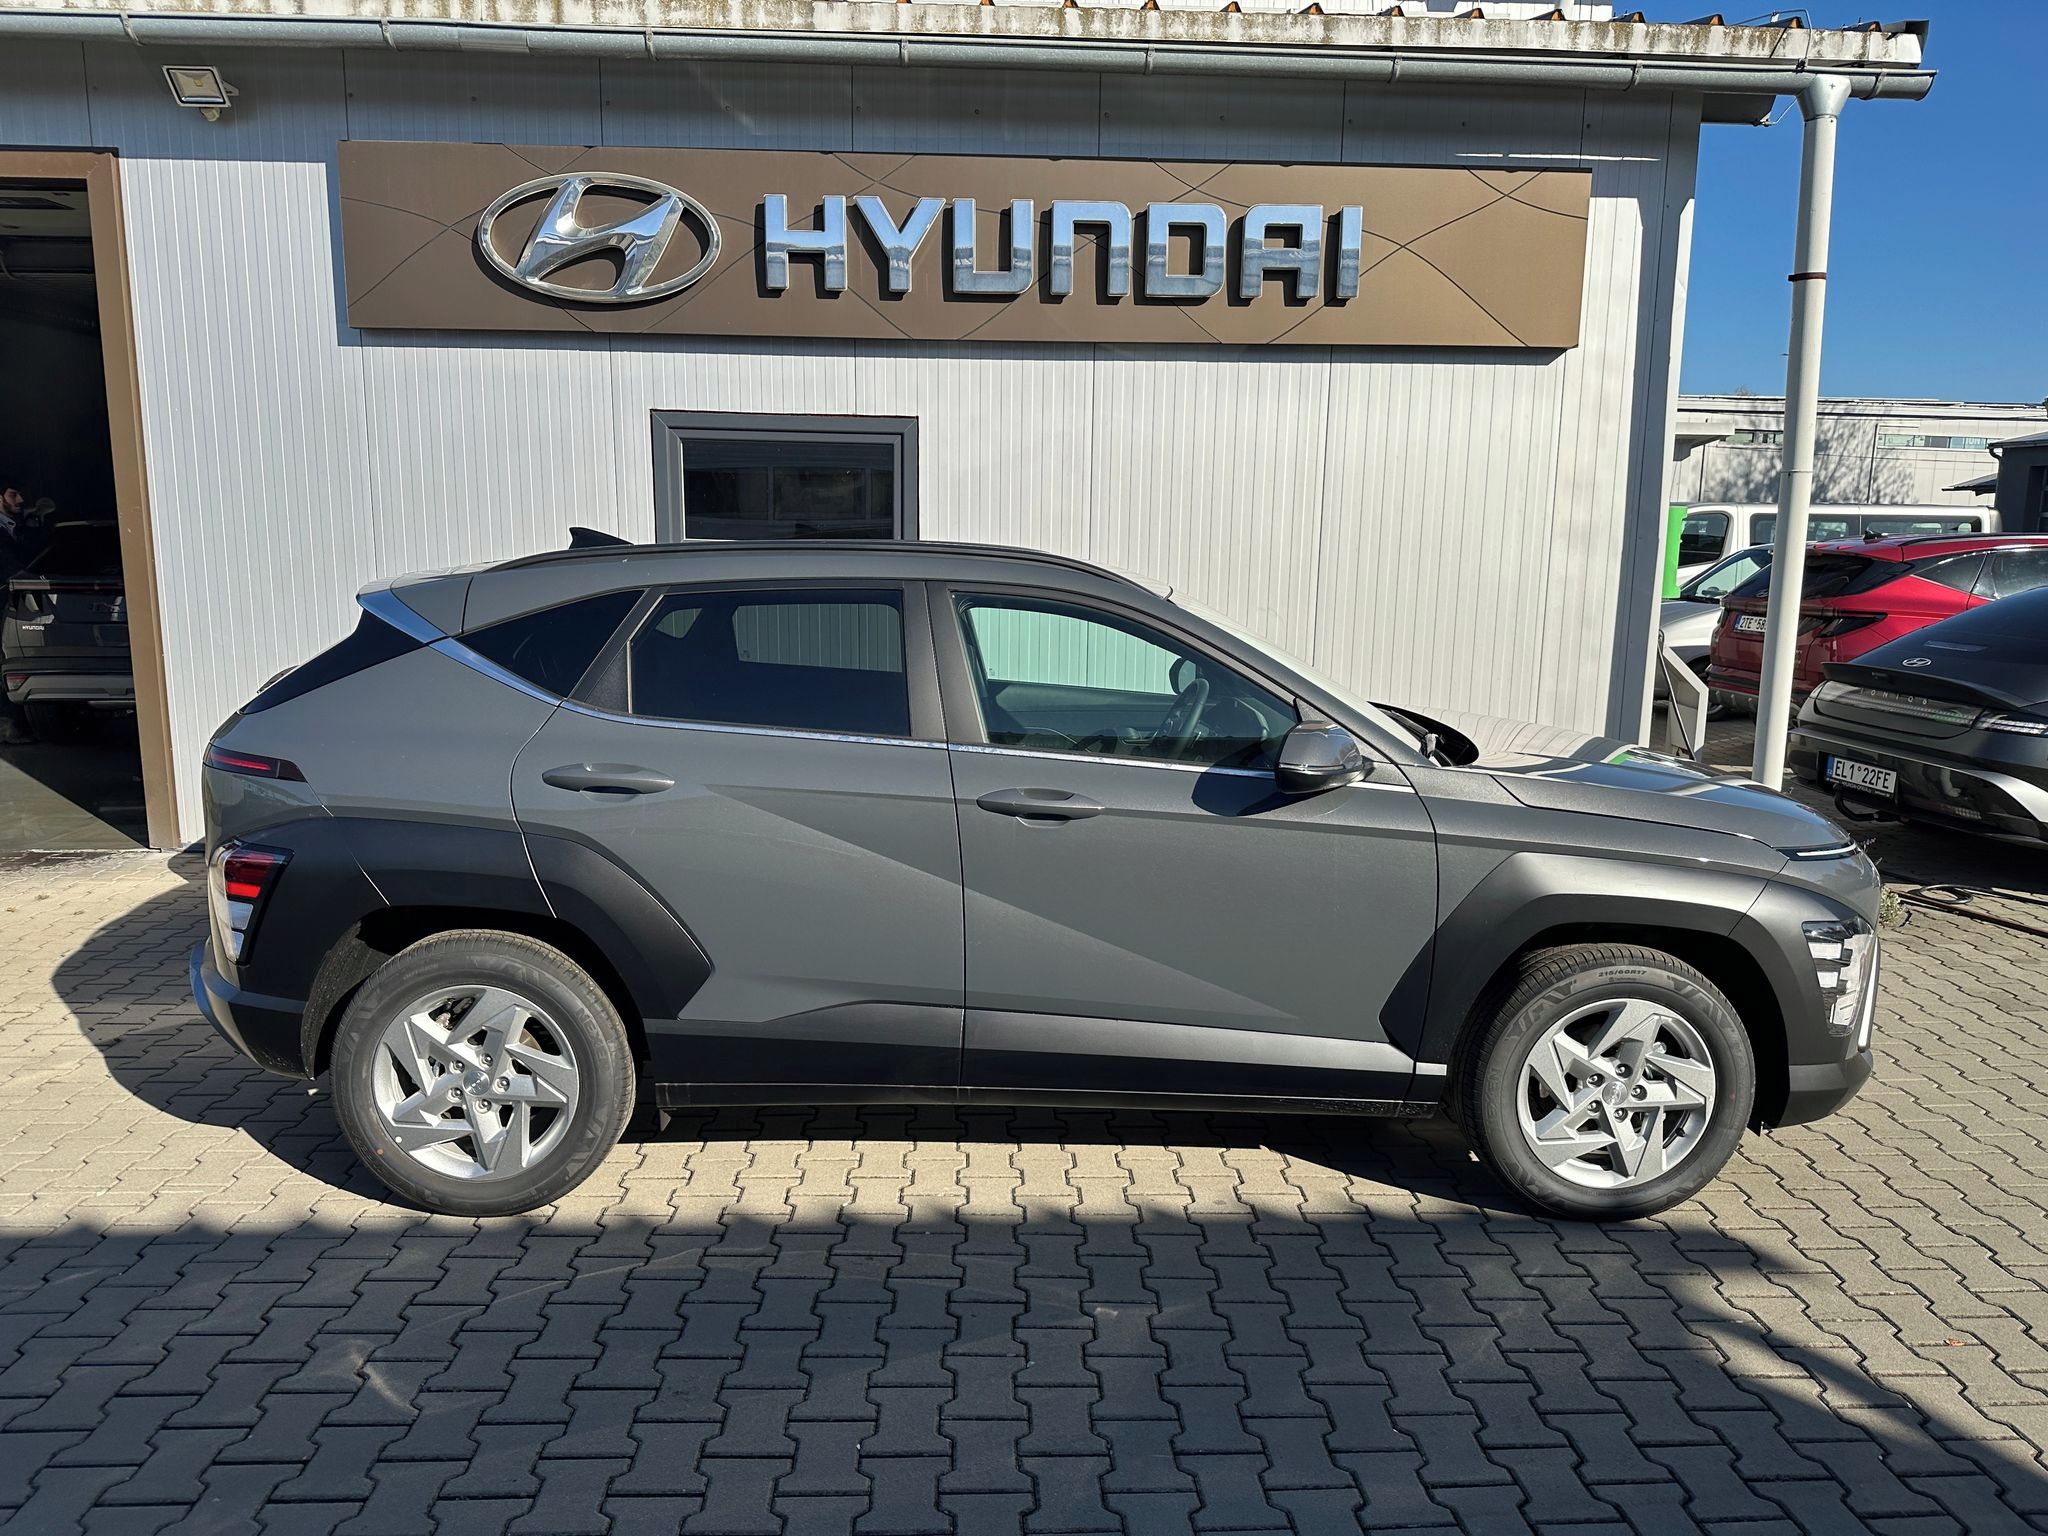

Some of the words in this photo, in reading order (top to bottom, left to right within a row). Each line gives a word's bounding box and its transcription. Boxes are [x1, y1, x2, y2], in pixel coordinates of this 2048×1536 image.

[763, 193, 1363, 299] HYUNDAI
[1740, 617, 1754, 629] 2TE
[1860, 688, 1914, 703] IONIQ
[1834, 760, 1855, 780] EL1
[1861, 767, 1892, 790] 22FE
